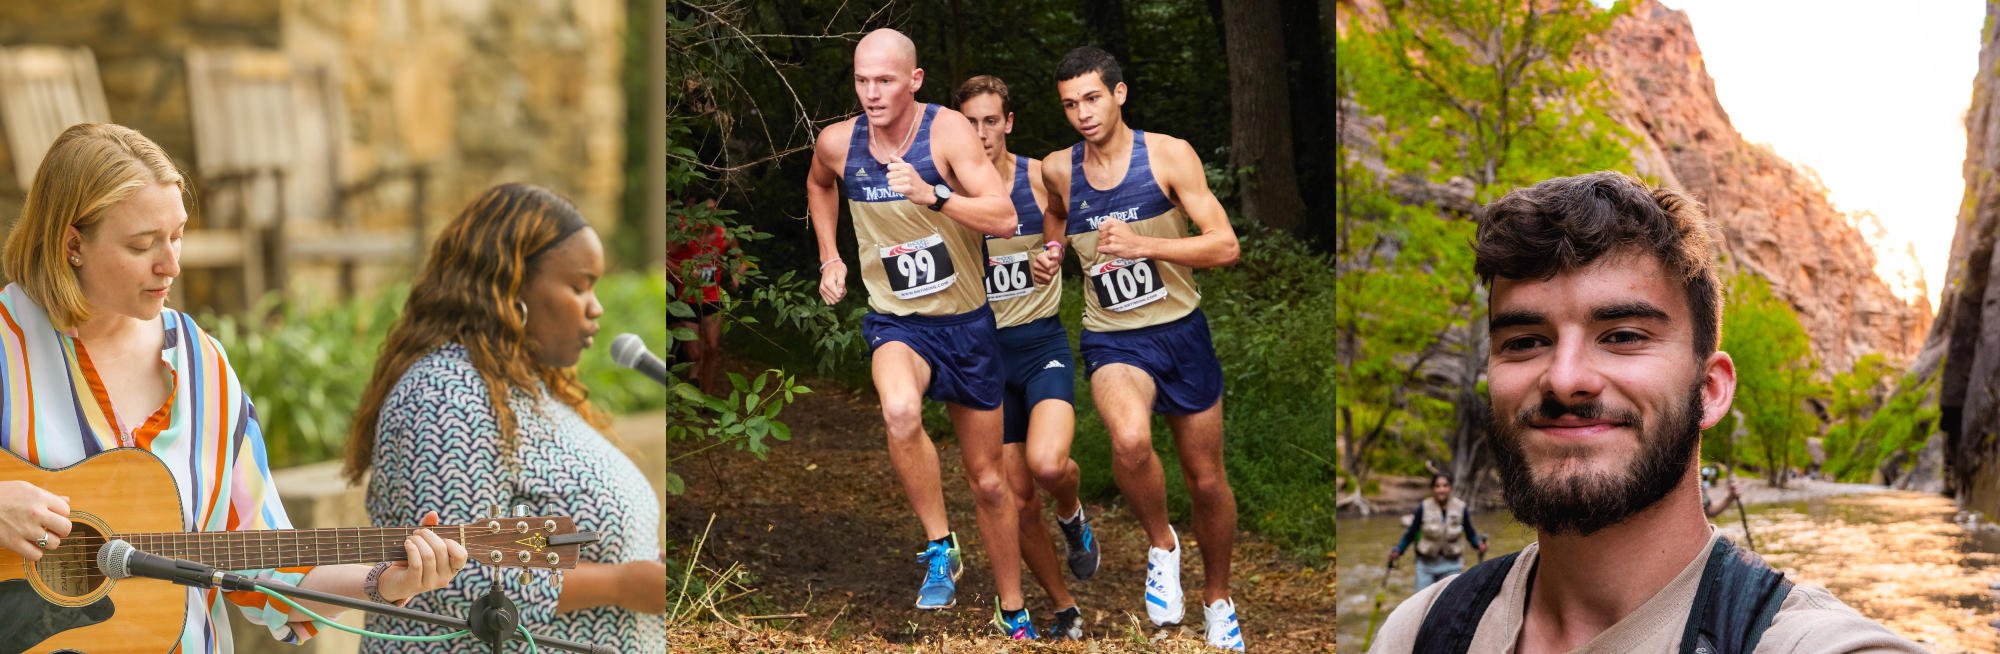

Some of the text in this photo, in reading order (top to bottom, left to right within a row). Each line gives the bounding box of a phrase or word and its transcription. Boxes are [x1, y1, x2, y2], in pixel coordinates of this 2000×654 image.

[897, 250, 935, 288] 99
[986, 262, 1027, 293] 106
[1101, 261, 1153, 304] 109
